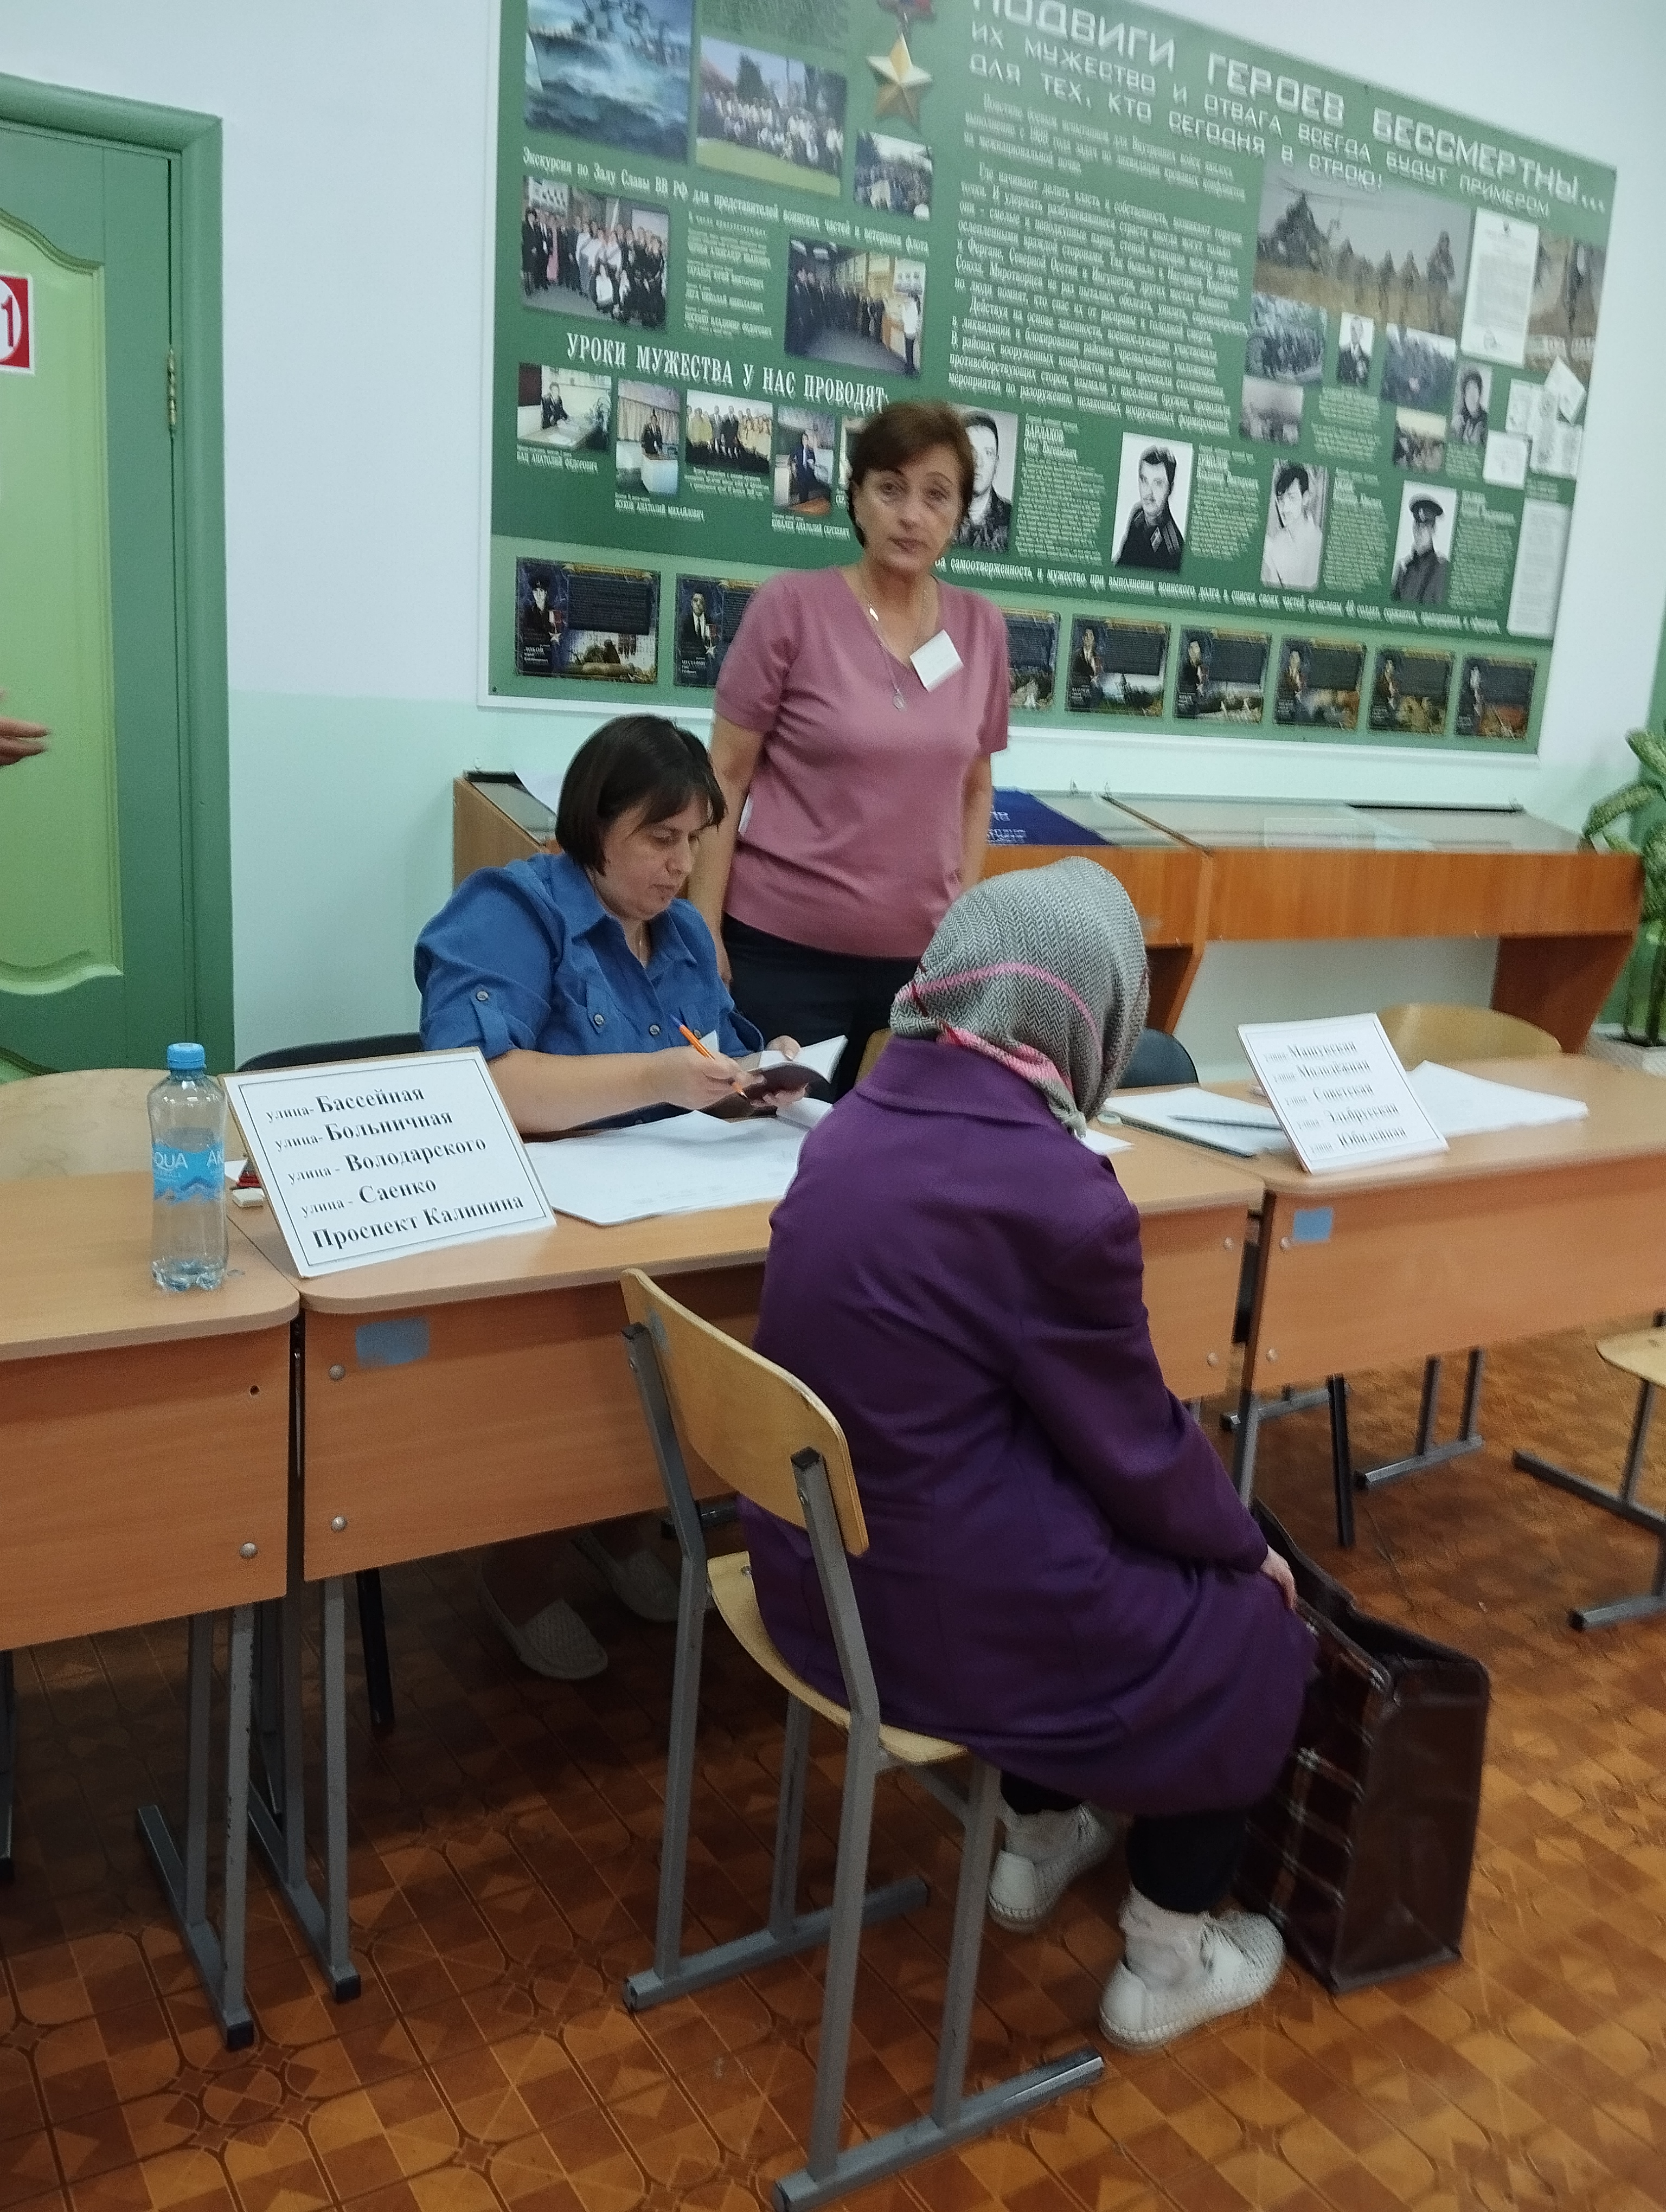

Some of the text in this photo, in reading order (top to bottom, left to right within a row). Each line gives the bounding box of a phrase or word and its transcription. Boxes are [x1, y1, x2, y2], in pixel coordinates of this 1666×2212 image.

[969, 53, 1382, 192] ДЛЯ ТЕХ, КТО СЕГОДНЯ В СТРОЮ!
[972, 0, 1606, 214] ОДВИГИ ГЕРОЕВ БЕССМЕРТНЫ...
[972, 20, 1551, 219] ИХ МУЖЕСТВО И ОТВАГА ВСЕГДА БУДУТ ПРИМЕРОМ
[523, 145, 572, 176] Экскурсия
[577, 163, 589, 179] по
[593, 162, 616, 187] Залу
[621, 168, 651, 191] Славы
[655, 176, 669, 196] ВВ
[673, 179, 689, 202] РФ
[714, 194, 779, 222] представителей
[783, 208, 821, 232] воинских
[824, 218, 851, 237] частей
[864, 227, 902, 248] ветеранов
[989, 261, 1043, 289] Миротворцев
[954, 276, 965, 291] но
[970, 280, 992, 296] люди
[1033, 294, 1048, 307] кто
[1052, 298, 1070, 312] спас
[1087, 306, 1097, 318] от
[969, 294, 1009, 320] Действуя
[1013, 308, 1023, 321] на
[1027, 311, 1054, 327] основе
[962, 317, 1011, 339] ликвидации
[1024, 326, 1080, 351] блокировании
[1083, 340, 1114, 359] районов
[962, 335, 996, 356] районах
[999, 344, 1055, 369] вооруженных
[1058, 355, 1105, 375] конфликтов
[567, 332, 626, 368] УРОКИ
[636, 344, 734, 388] МУЖЕСТВА
[743, 363, 754, 391] У
[763, 366, 796, 398] НАС
[949, 353, 1038, 384] противоборствующих
[1040, 370, 1070, 388] сторон,
[1073, 376, 1108, 395] изымали
[1120, 385, 1159, 404] населения
[948, 372, 1175, 429] мероприятия по разоружению незаконных вооруженных
[795, 522, 823, 536] АНАТОЛИЙ
[823, 524, 851, 539] СЕРГЕЕВИЧ
[950, 557, 1033, 583] самоотверженность
[1037, 568, 1043, 581] и
[1047, 569, 1086, 588] мужество
[1090, 574, 1105, 591] при
[1108, 576, 1155, 595] выполнении
[1158, 582, 1196, 599] воинского
[1199, 586, 1220, 601] долга
[1231, 589, 1257, 606] списки
[315, 1088, 425, 1113] Бассейная
[1312, 1084, 1375, 1102] Советская
[1323, 1102, 1399, 1124] Эльбрусская
[324, 1112, 453, 1141] Больничная
[287, 1167, 332, 1186] улица
[344, 1139, 486, 1172] Володарского
[300, 1199, 345, 1218] улица
[358, 1179, 437, 1204] Саенко
[310, 1195, 524, 1250] Проспект Калинина
